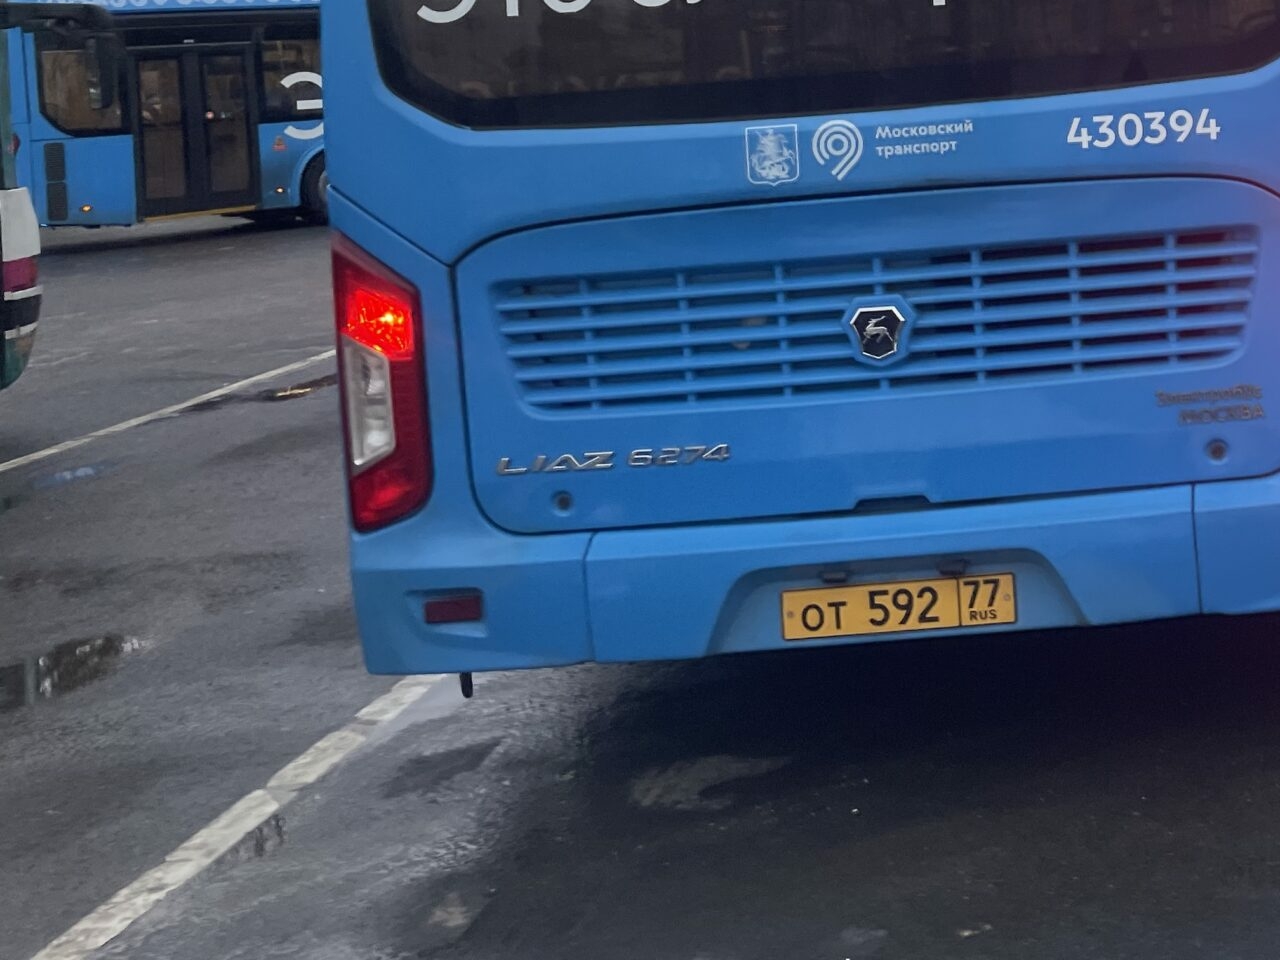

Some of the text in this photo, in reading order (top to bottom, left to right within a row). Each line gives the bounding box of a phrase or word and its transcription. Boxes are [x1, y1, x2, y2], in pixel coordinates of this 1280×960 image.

[875, 119, 974, 140] Московский
[1066, 108, 1221, 149] 430394
[875, 139, 958, 158] транспорт
[497, 443, 731, 476] LIAZ 6274
[867, 586, 940, 627] 592
[962, 578, 1000, 609] 77
[968, 608, 998, 622] RUS
